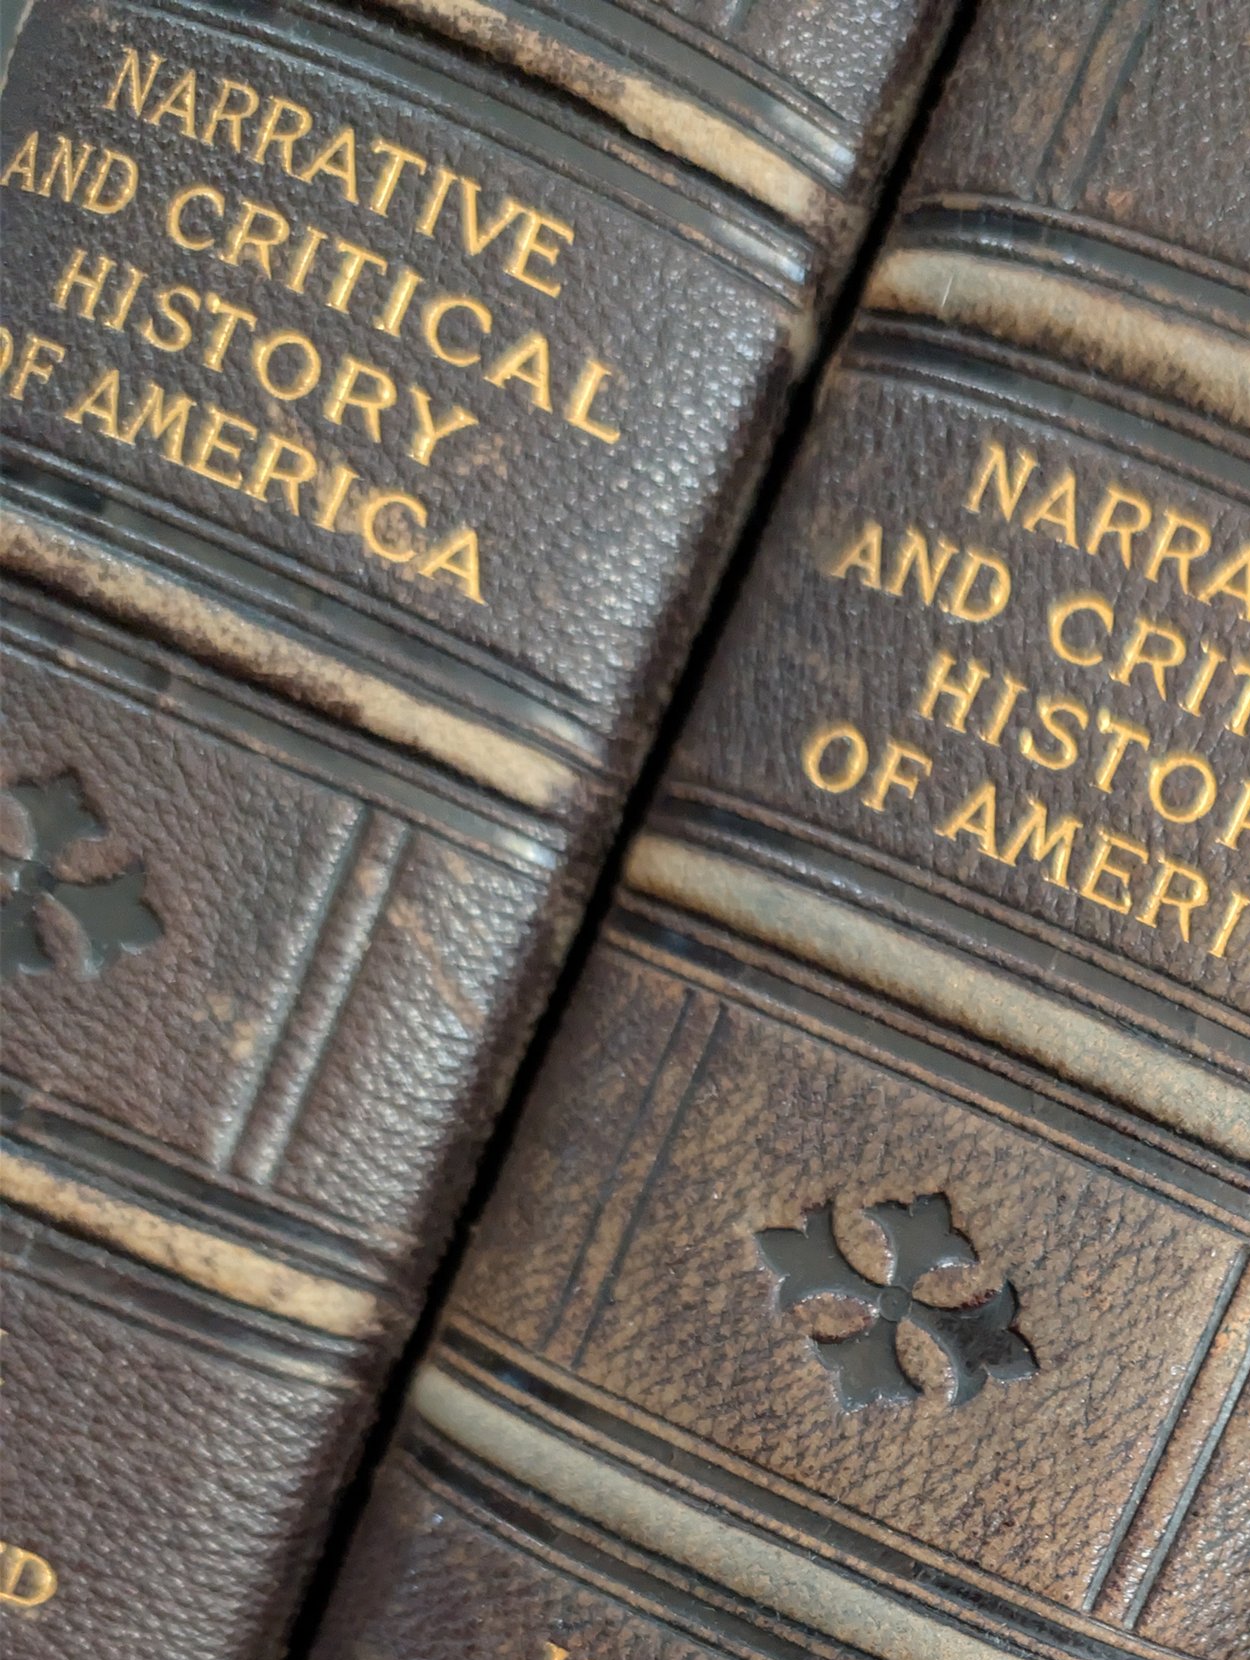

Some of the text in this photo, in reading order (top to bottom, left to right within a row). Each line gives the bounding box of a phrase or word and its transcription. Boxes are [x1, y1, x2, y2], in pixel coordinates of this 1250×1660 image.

[0, 130, 620, 444] AND CRITICAL
[104, 47, 574, 298] NARRATIVE
[0, 326, 486, 605] F AMERICA
[51, 249, 478, 466] HISTORY
[831, 522, 1011, 623] AND
[805, 724, 932, 811] OF
